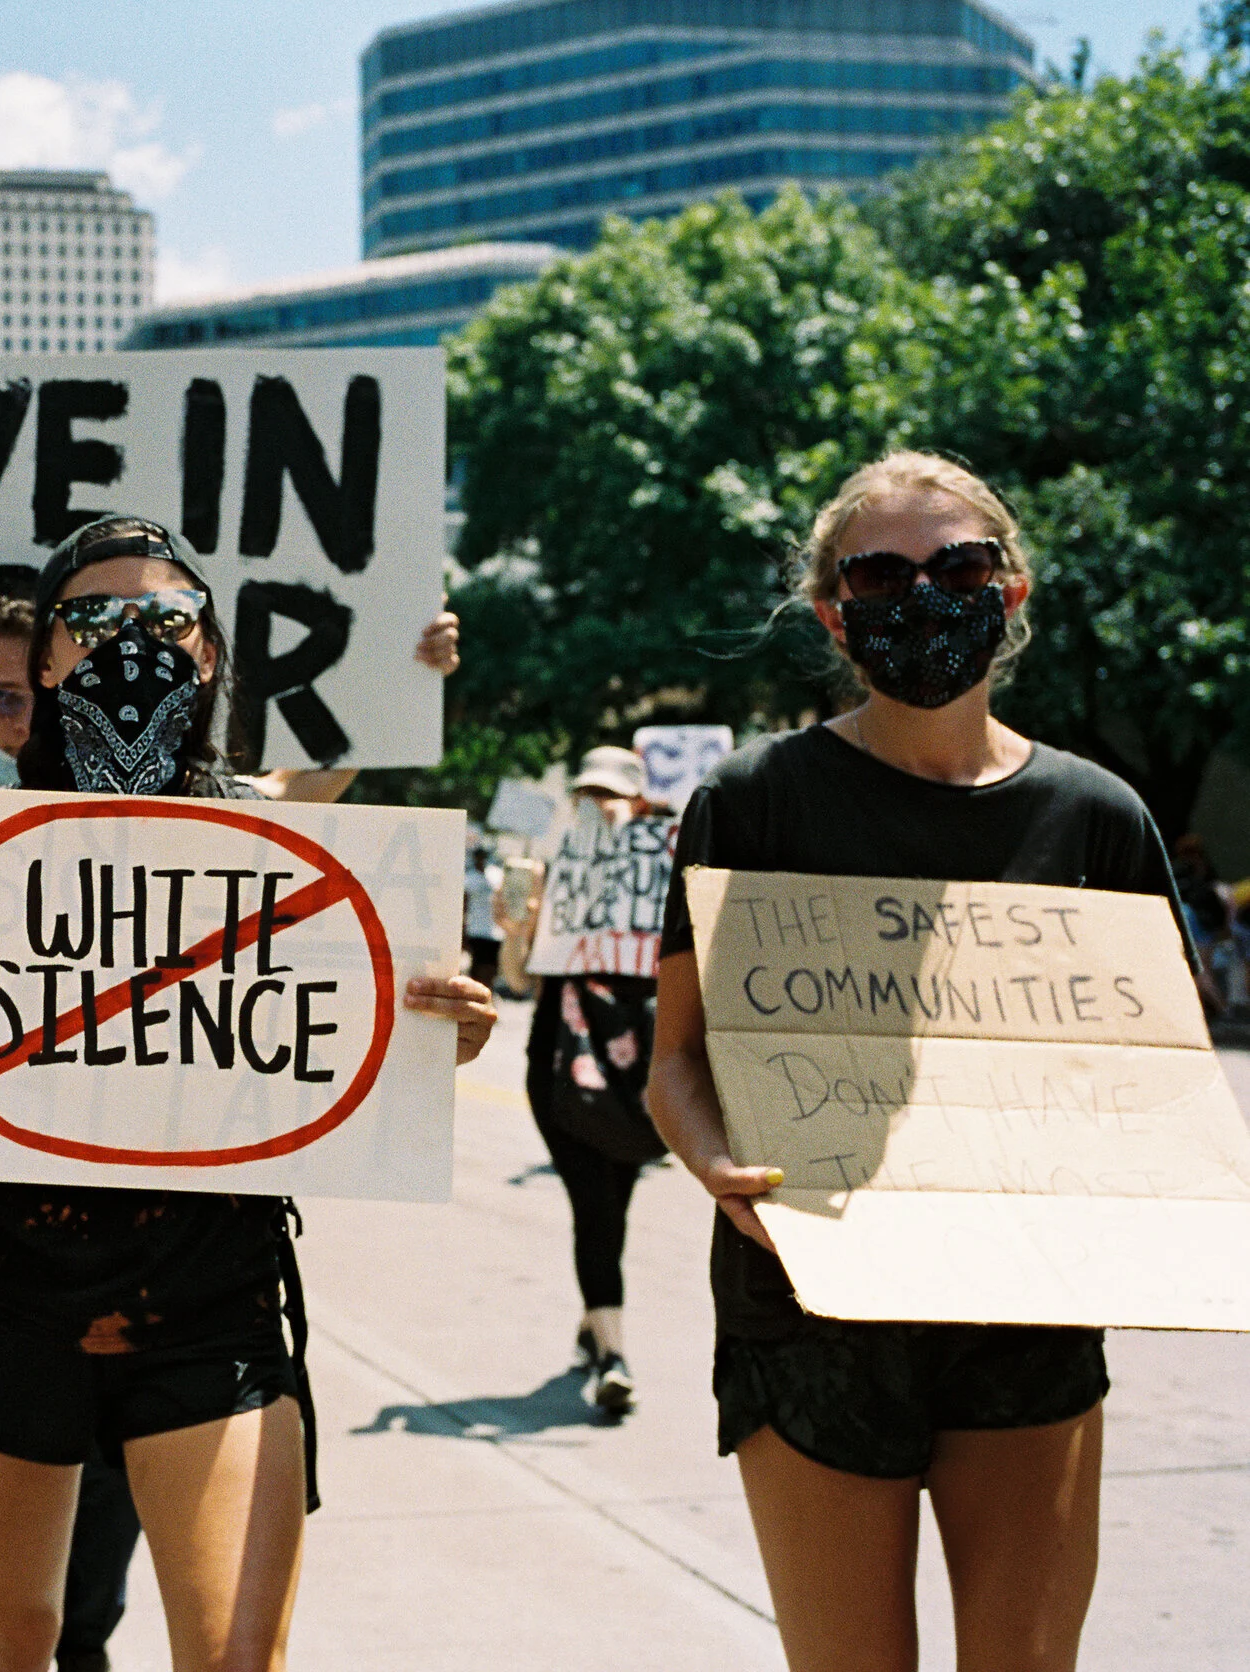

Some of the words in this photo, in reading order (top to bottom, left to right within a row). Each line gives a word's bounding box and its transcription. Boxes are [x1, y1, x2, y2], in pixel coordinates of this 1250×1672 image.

[181, 373, 381, 574] IN
[26, 857, 294, 978] WHITE
[734, 894, 838, 949] THE
[874, 895, 1081, 950] SAFEST
[744, 964, 1145, 1024] COMMUNITIES
[984, 1072, 1152, 1135] HAVE
